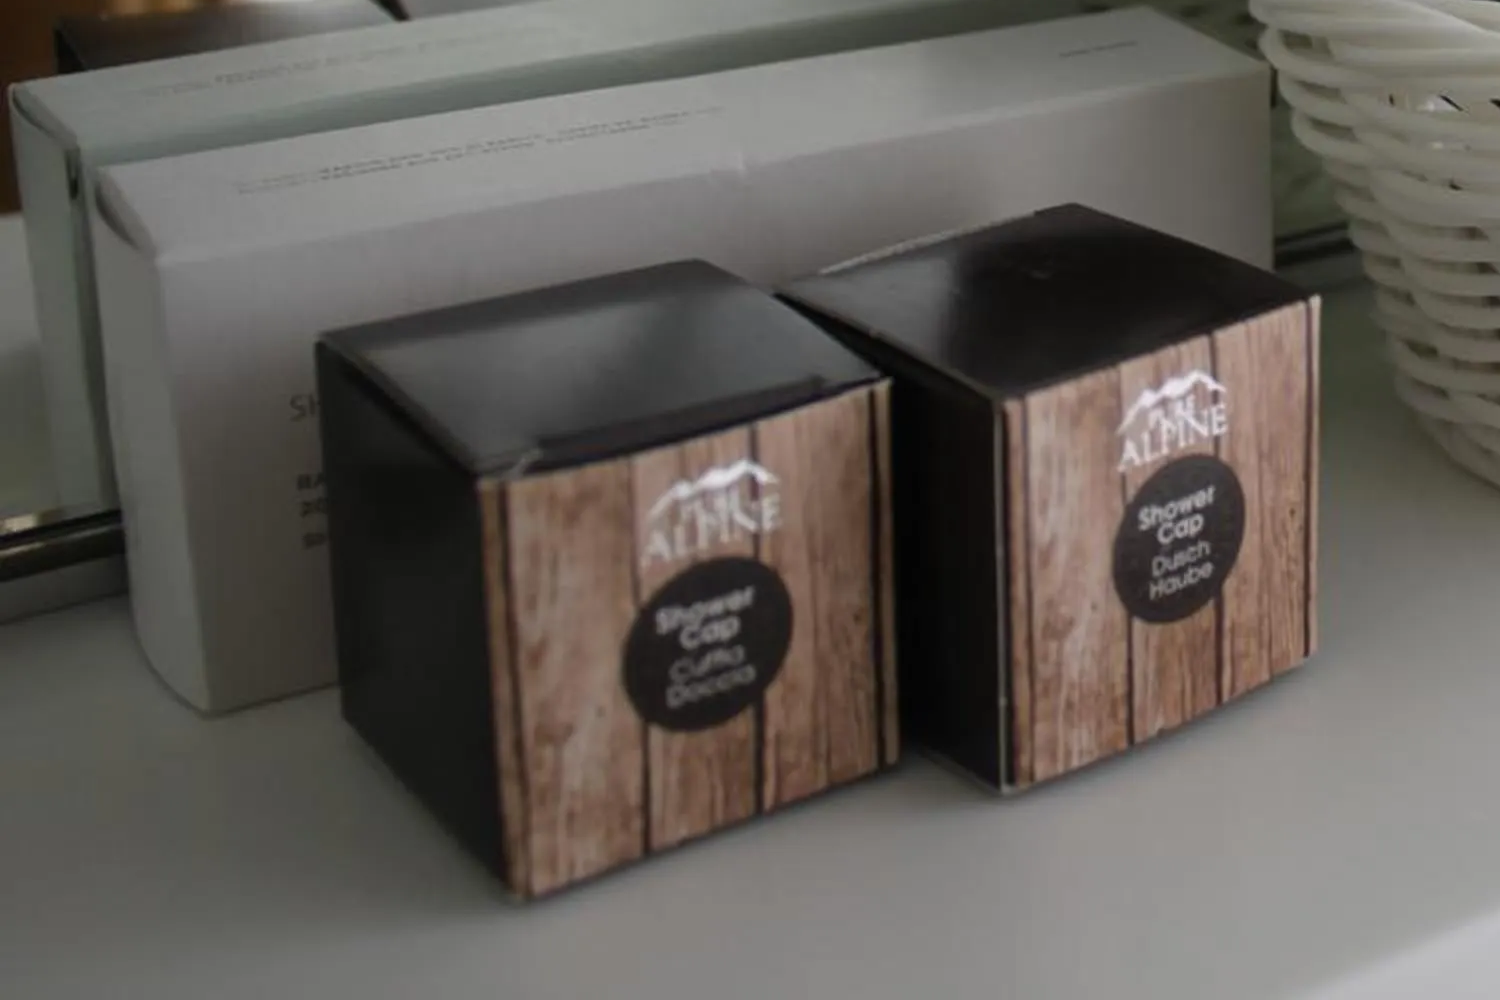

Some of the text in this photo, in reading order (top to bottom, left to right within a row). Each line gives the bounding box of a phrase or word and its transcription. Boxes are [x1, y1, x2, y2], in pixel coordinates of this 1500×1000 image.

[1117, 405, 1229, 472] ALPINE
[1138, 486, 1216, 532] Shower
[1157, 513, 1204, 545] Cap
[1149, 562, 1214, 600] Haube
[656, 587, 755, 635] Shower
[680, 616, 740, 651] Cap
